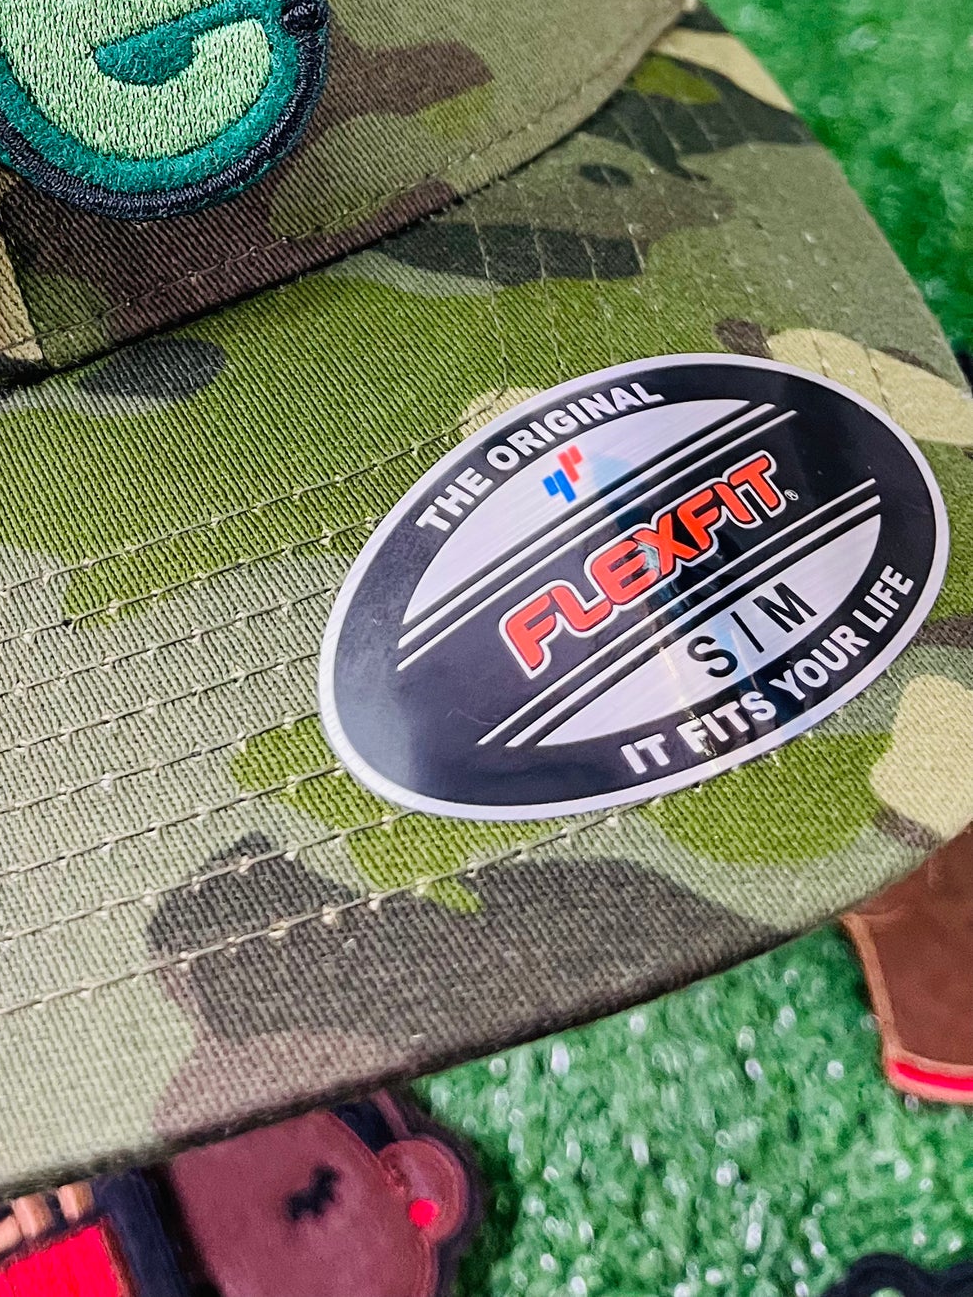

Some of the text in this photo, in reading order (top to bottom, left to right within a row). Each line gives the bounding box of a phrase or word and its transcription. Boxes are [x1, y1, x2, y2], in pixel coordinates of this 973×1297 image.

[415, 382, 665, 532] THE ORIGINAL
[499, 451, 784, 679] FLEXFIT
[620, 564, 914, 775] IT FITS YOUR LIFE
